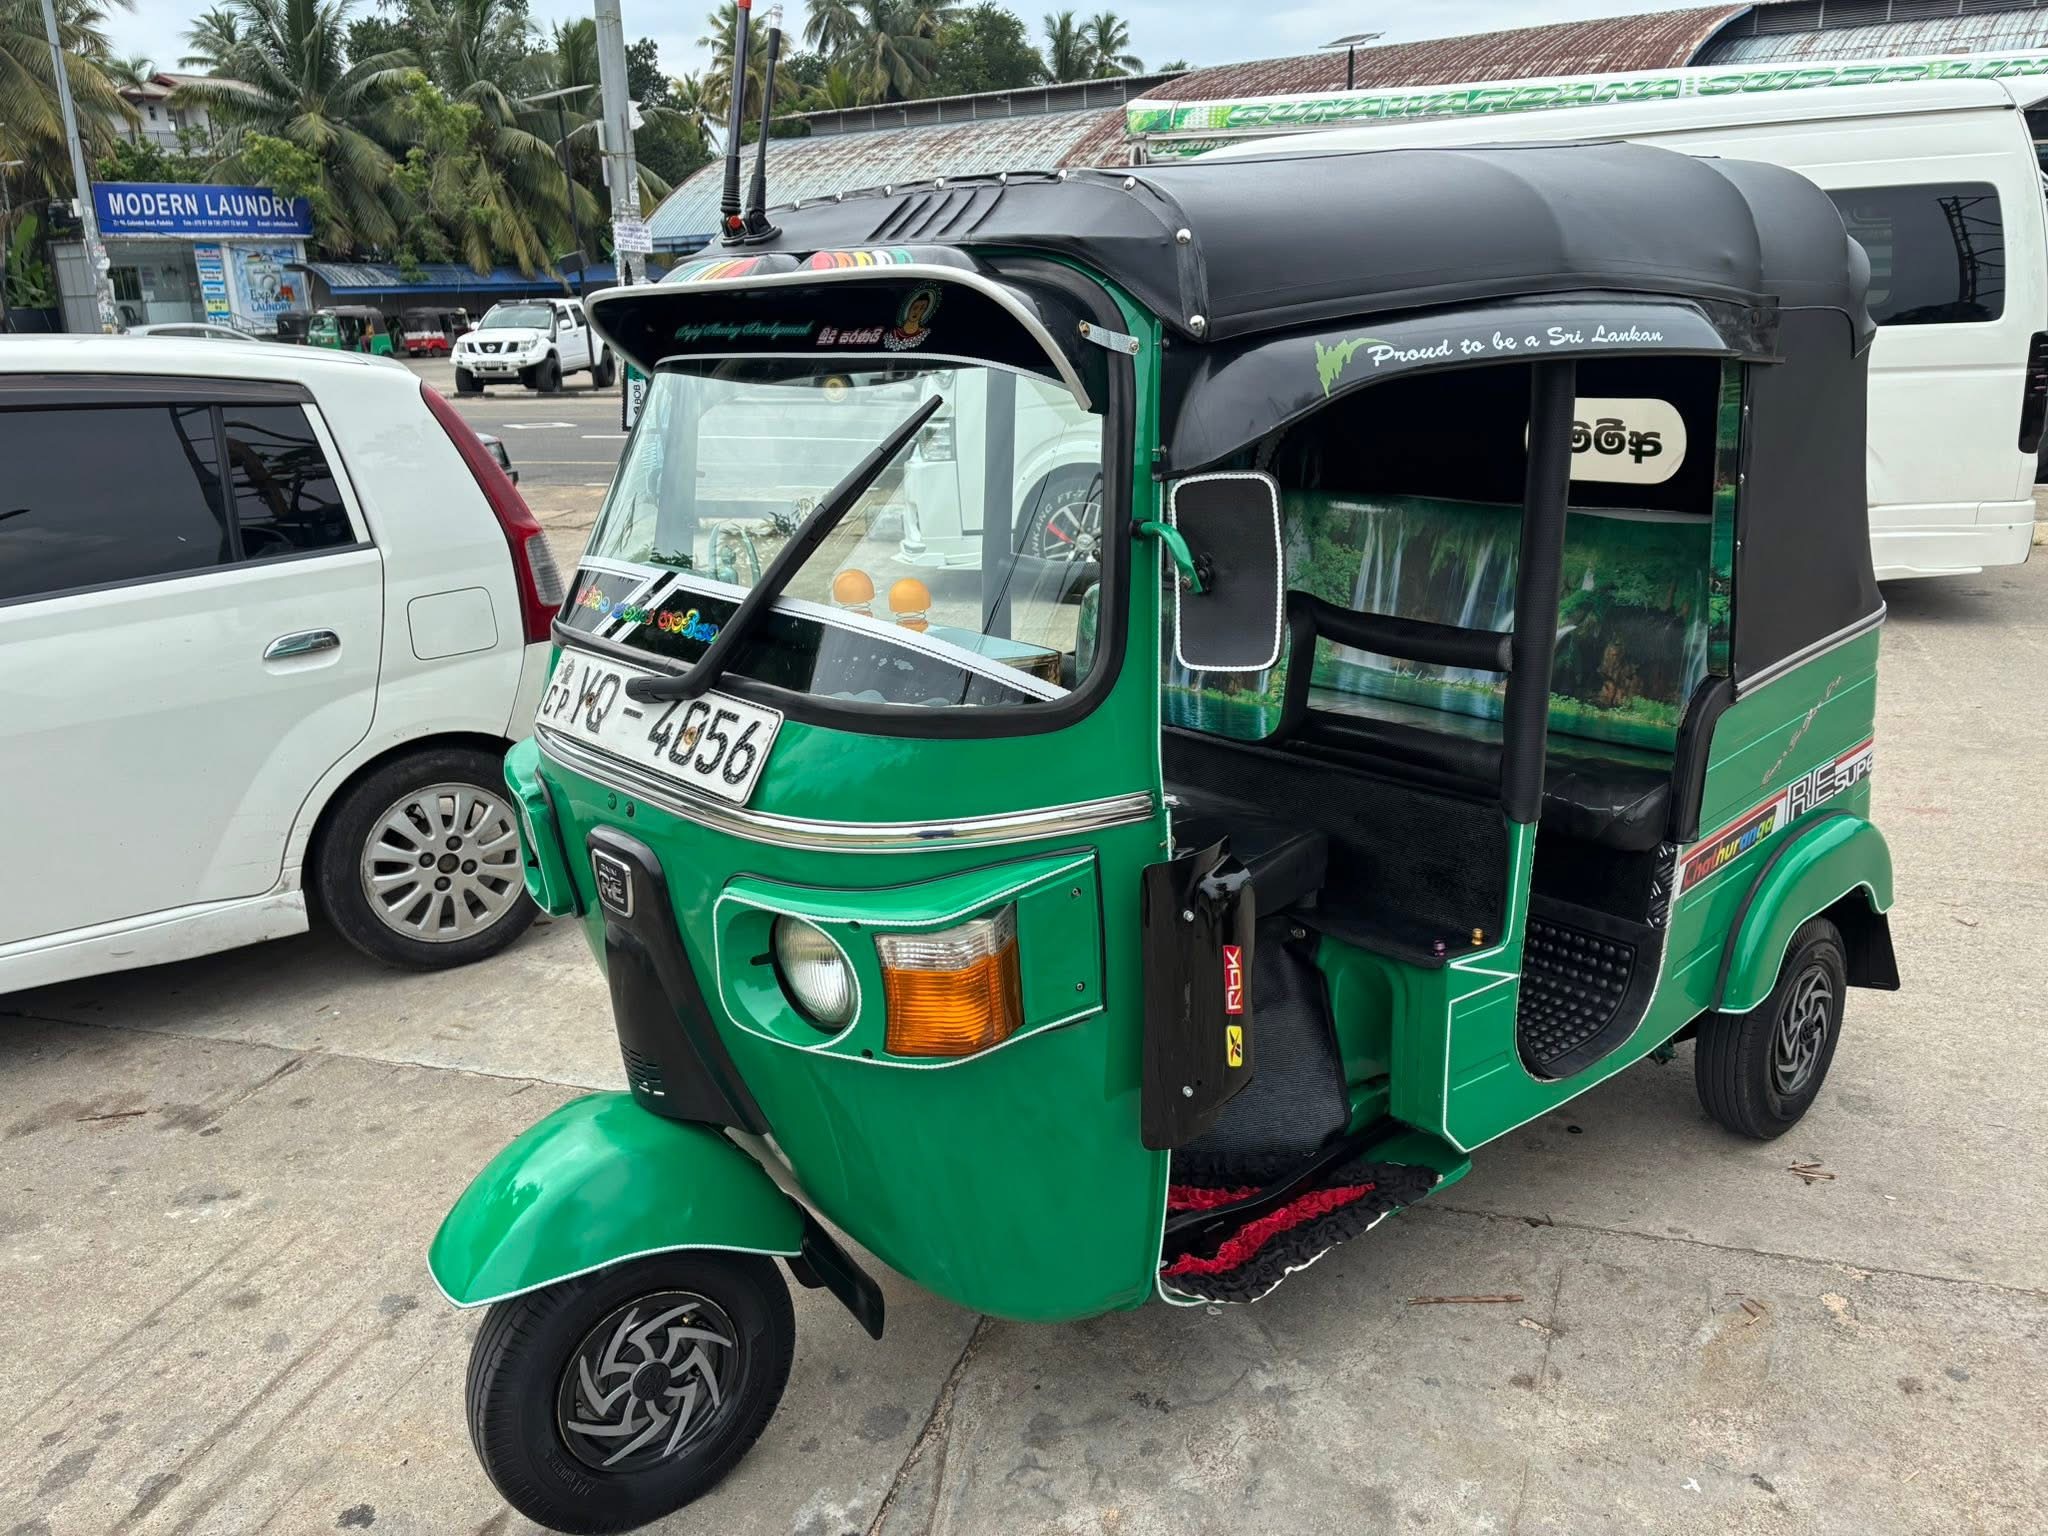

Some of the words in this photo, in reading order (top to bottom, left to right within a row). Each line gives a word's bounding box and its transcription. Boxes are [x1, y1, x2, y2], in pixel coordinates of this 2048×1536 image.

[1697, 64, 1930, 95] SUPER
[1151, 137, 1239, 154] Goodby
[108, 193, 199, 216] MODERN
[206, 194, 295, 217] LAUNDRY
[251, 303, 292, 312] LAUNDRY
[1367, 339, 1453, 367] Proud
[1460, 336, 1486, 355] to
[1492, 331, 1517, 350] be
[1525, 334, 1540, 347] a
[1547, 327, 1584, 346] Sri
[1591, 325, 1664, 343] Lankan
[1786, 760, 1836, 825] RE
[1684, 815, 1776, 887] Chathuranga
